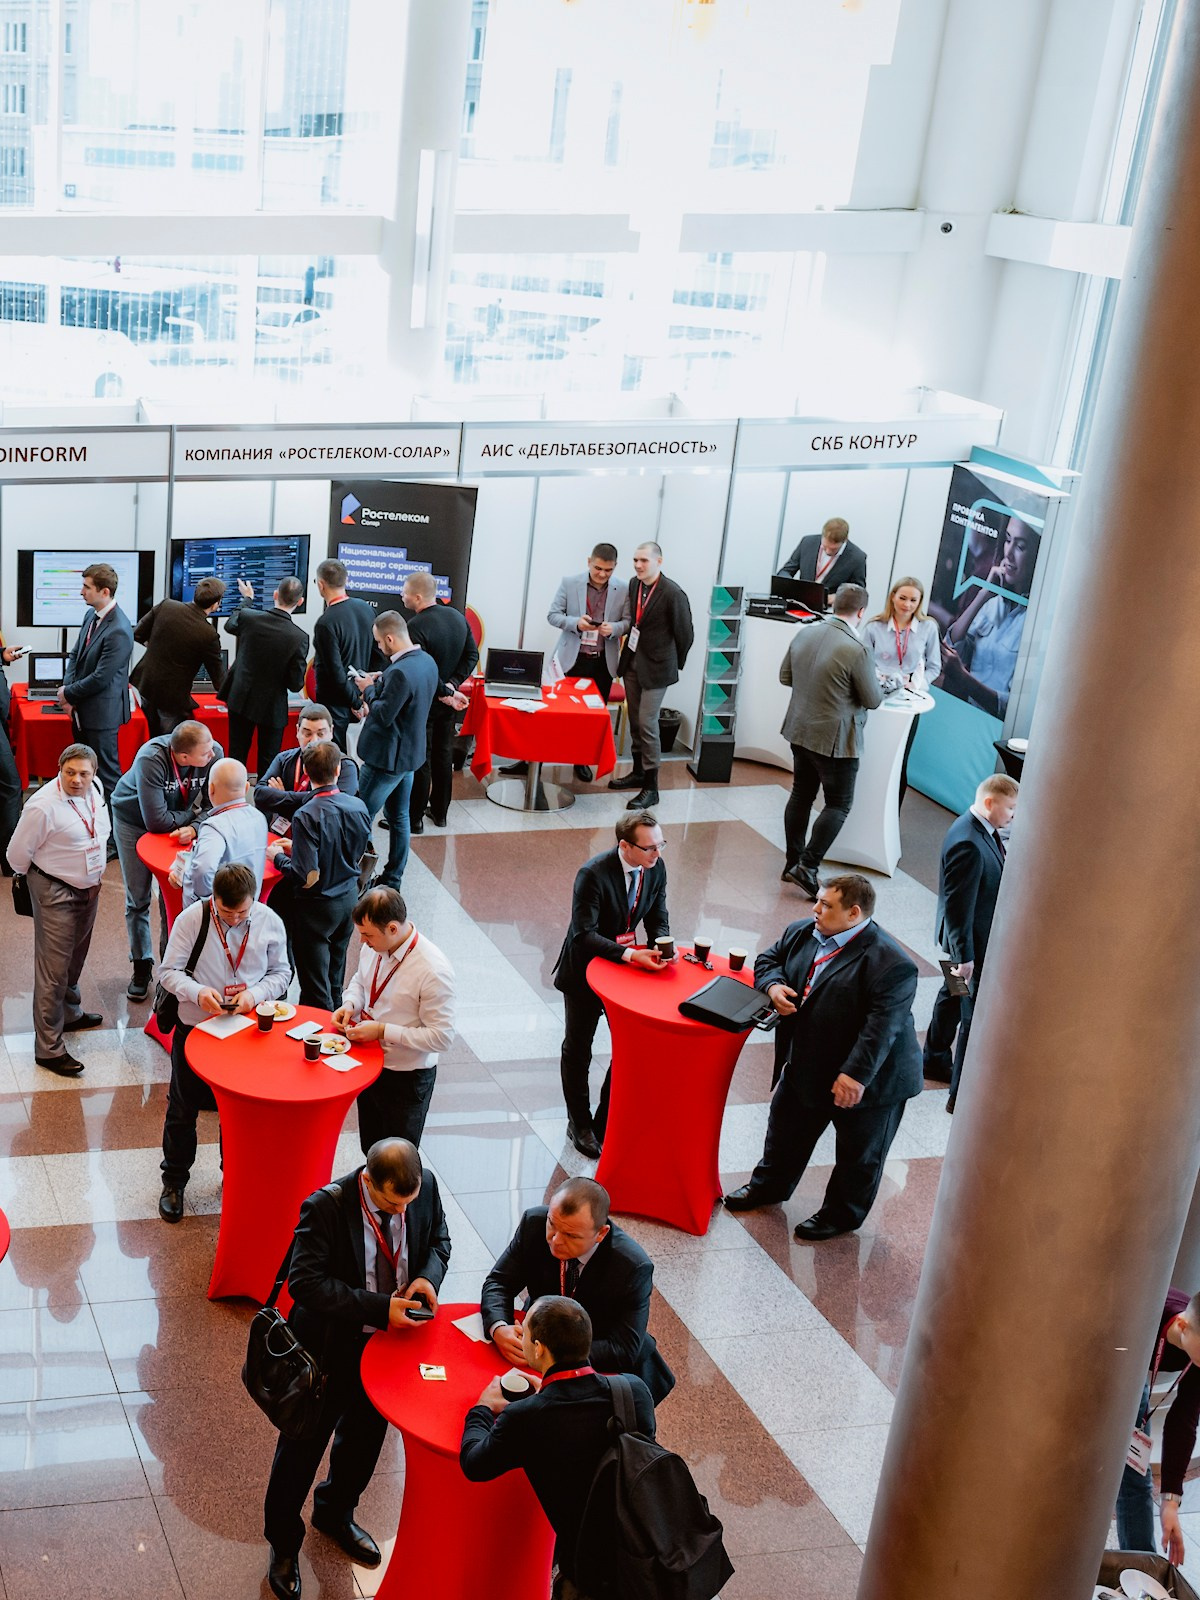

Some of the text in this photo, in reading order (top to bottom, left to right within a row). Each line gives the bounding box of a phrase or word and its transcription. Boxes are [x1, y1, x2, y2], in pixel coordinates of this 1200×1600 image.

[481, 440, 718, 458] АИС «ДЕЛЬТАБЕЗОПАСНОСТЬ»
[811, 433, 918, 451] СКБ КОНТУР
[184, 445, 452, 462] КОМПАНИЯ «РОСТЕЛЕКОМ-СОЛАР»
[361, 508, 430, 524] Ростелеком
[952, 502, 985, 523] ПРОВЕРКА
[950, 514, 999, 539] КОНТРАГЕНТОВ
[340, 546, 404, 558] Национальный
[347, 570, 408, 582] технологий дл
[388, 563, 429, 573] сервисов
